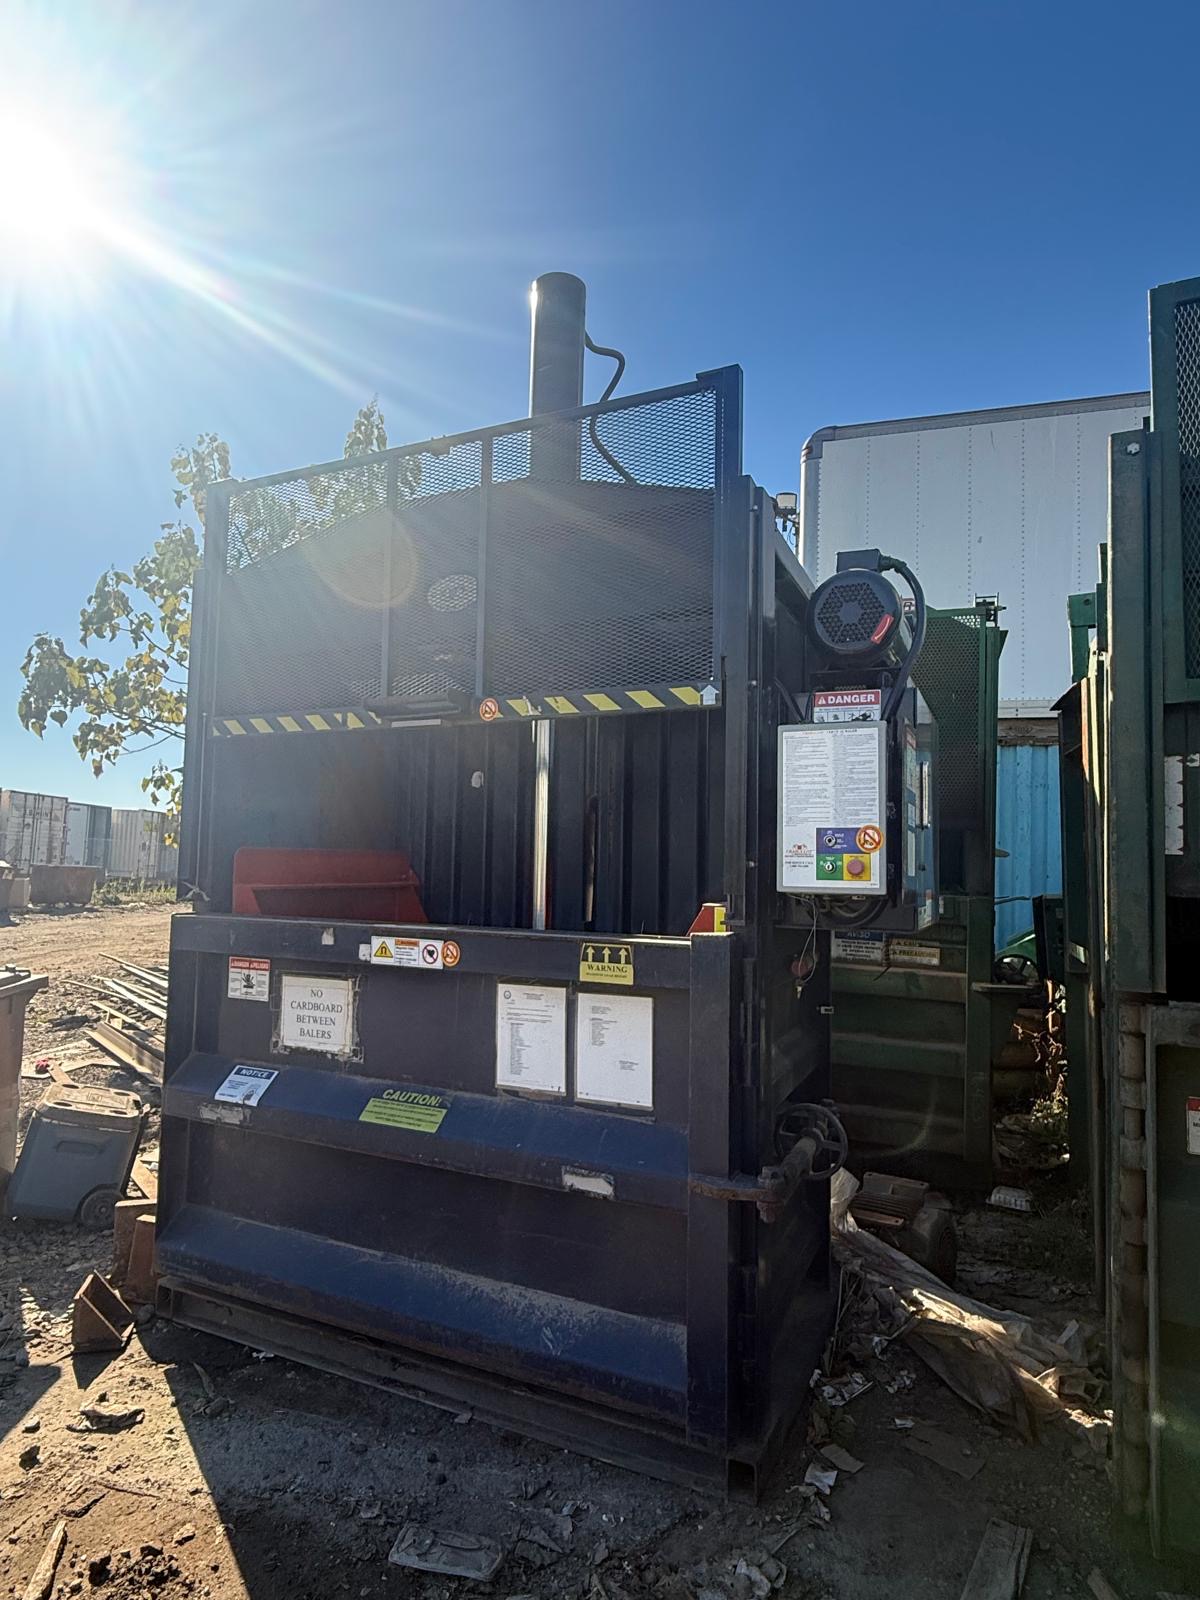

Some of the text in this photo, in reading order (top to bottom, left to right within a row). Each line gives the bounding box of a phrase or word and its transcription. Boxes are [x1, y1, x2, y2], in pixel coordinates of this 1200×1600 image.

[827, 694, 875, 704] DANGER
[587, 963, 628, 973] WARNING
[310, 988, 323, 998] NO
[290, 1000, 343, 1014] CARDBOARD
[296, 1014, 336, 1026] BETWEEN
[299, 1027, 332, 1040] BALERS
[240, 1069, 270, 1078] NOTICE
[382, 1088, 442, 1107] CAUTION!
